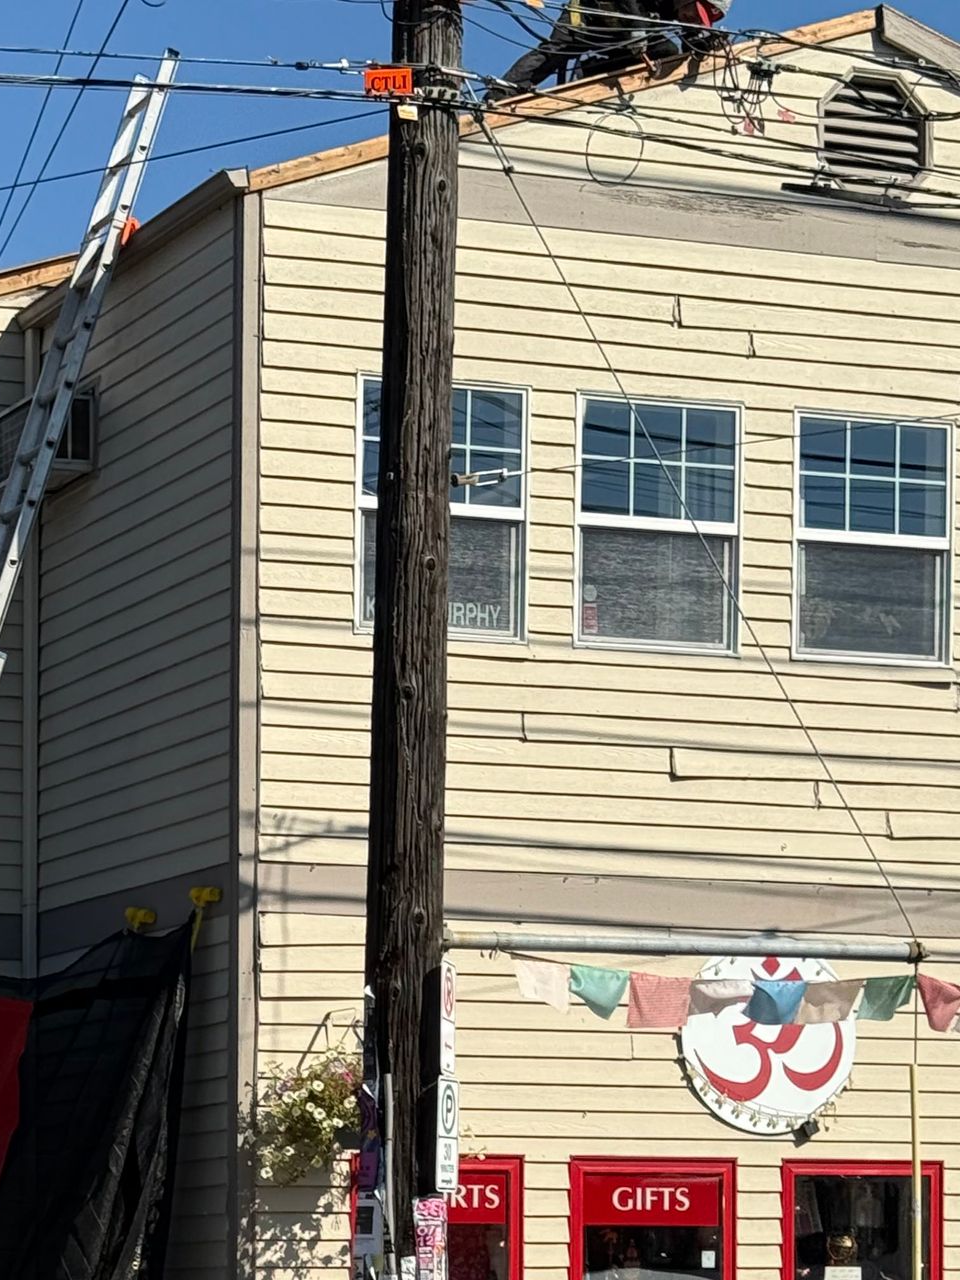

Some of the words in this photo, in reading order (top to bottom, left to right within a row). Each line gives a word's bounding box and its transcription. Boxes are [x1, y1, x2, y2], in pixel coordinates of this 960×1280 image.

[371, 75, 408, 91] CTLI
[445, 1094, 453, 1124] P
[612, 1186, 690, 1211] GIFTS
